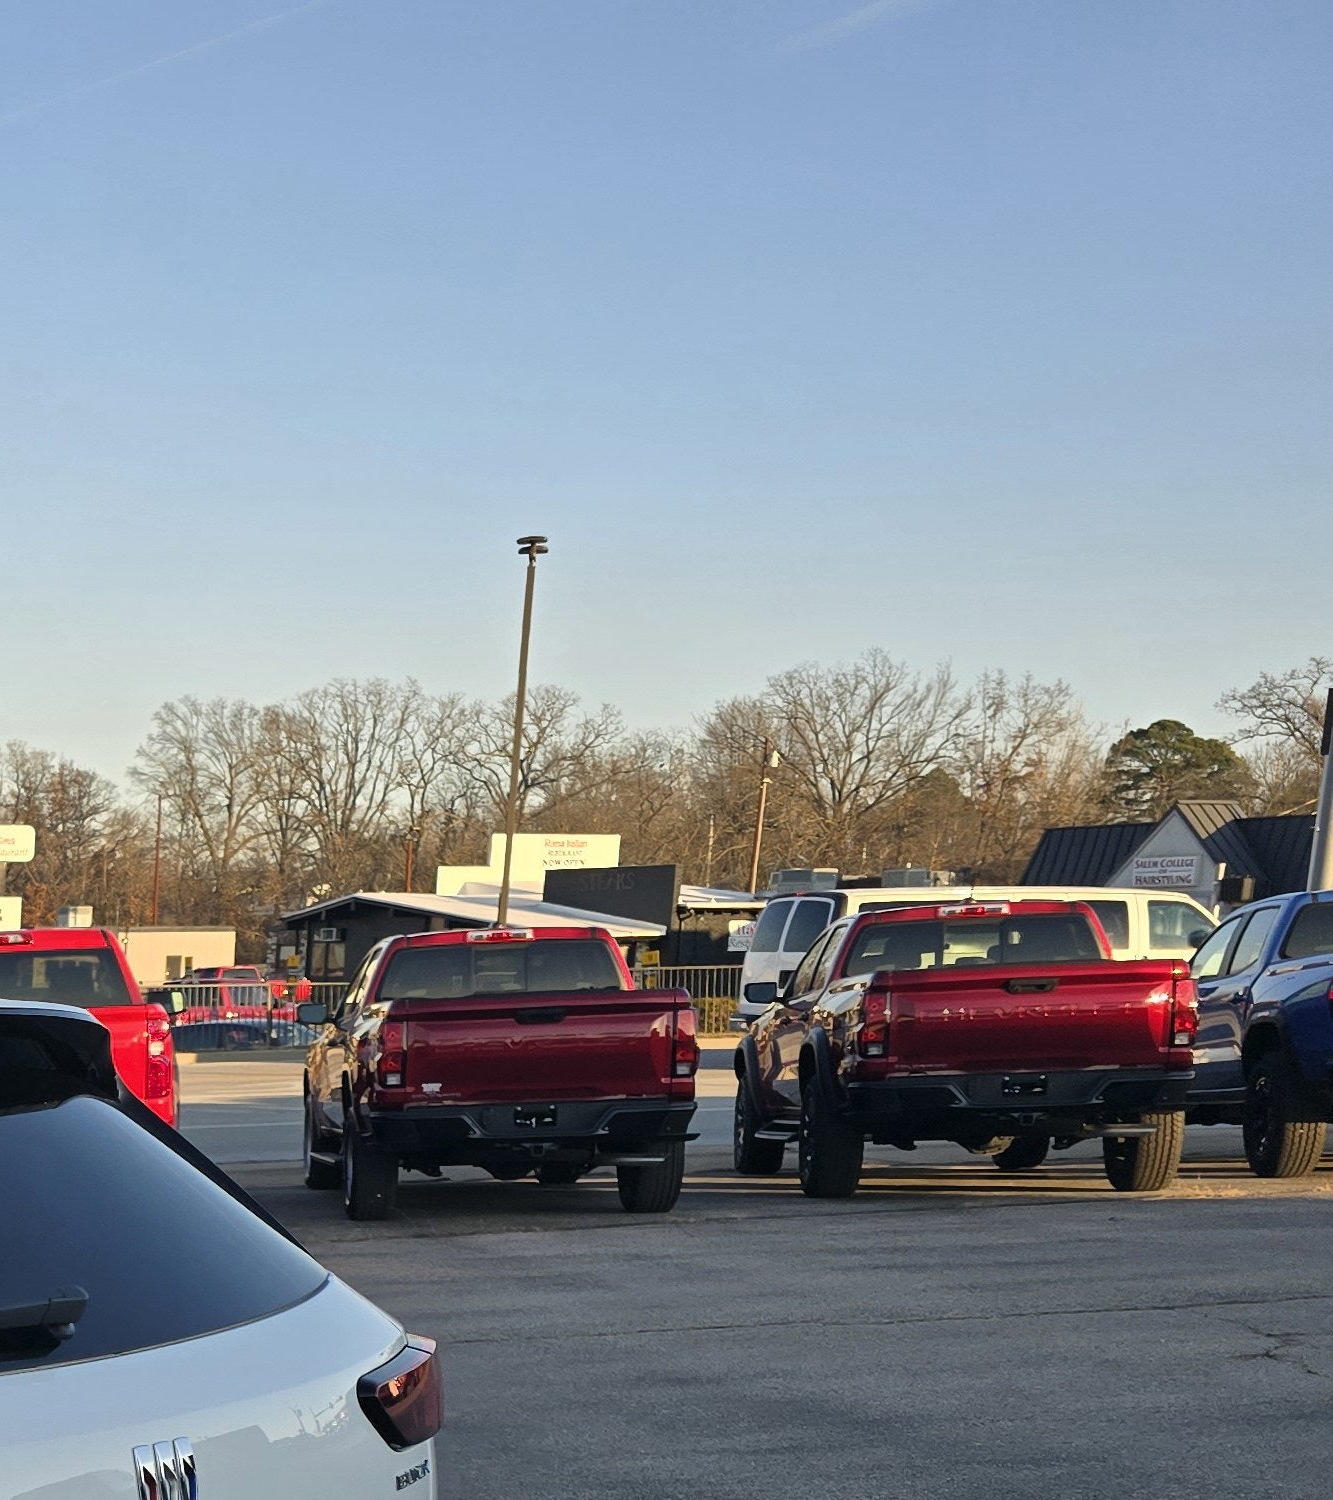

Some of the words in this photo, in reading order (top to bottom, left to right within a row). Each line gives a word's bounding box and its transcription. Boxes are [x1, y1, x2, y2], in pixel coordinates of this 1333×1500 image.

[1134, 860, 1158, 869] SALEM
[1160, 858, 1194, 869] COLLEGE
[1134, 874, 1192, 886] HAIRSTYLING
[395, 1459, 431, 1491] BUICK
